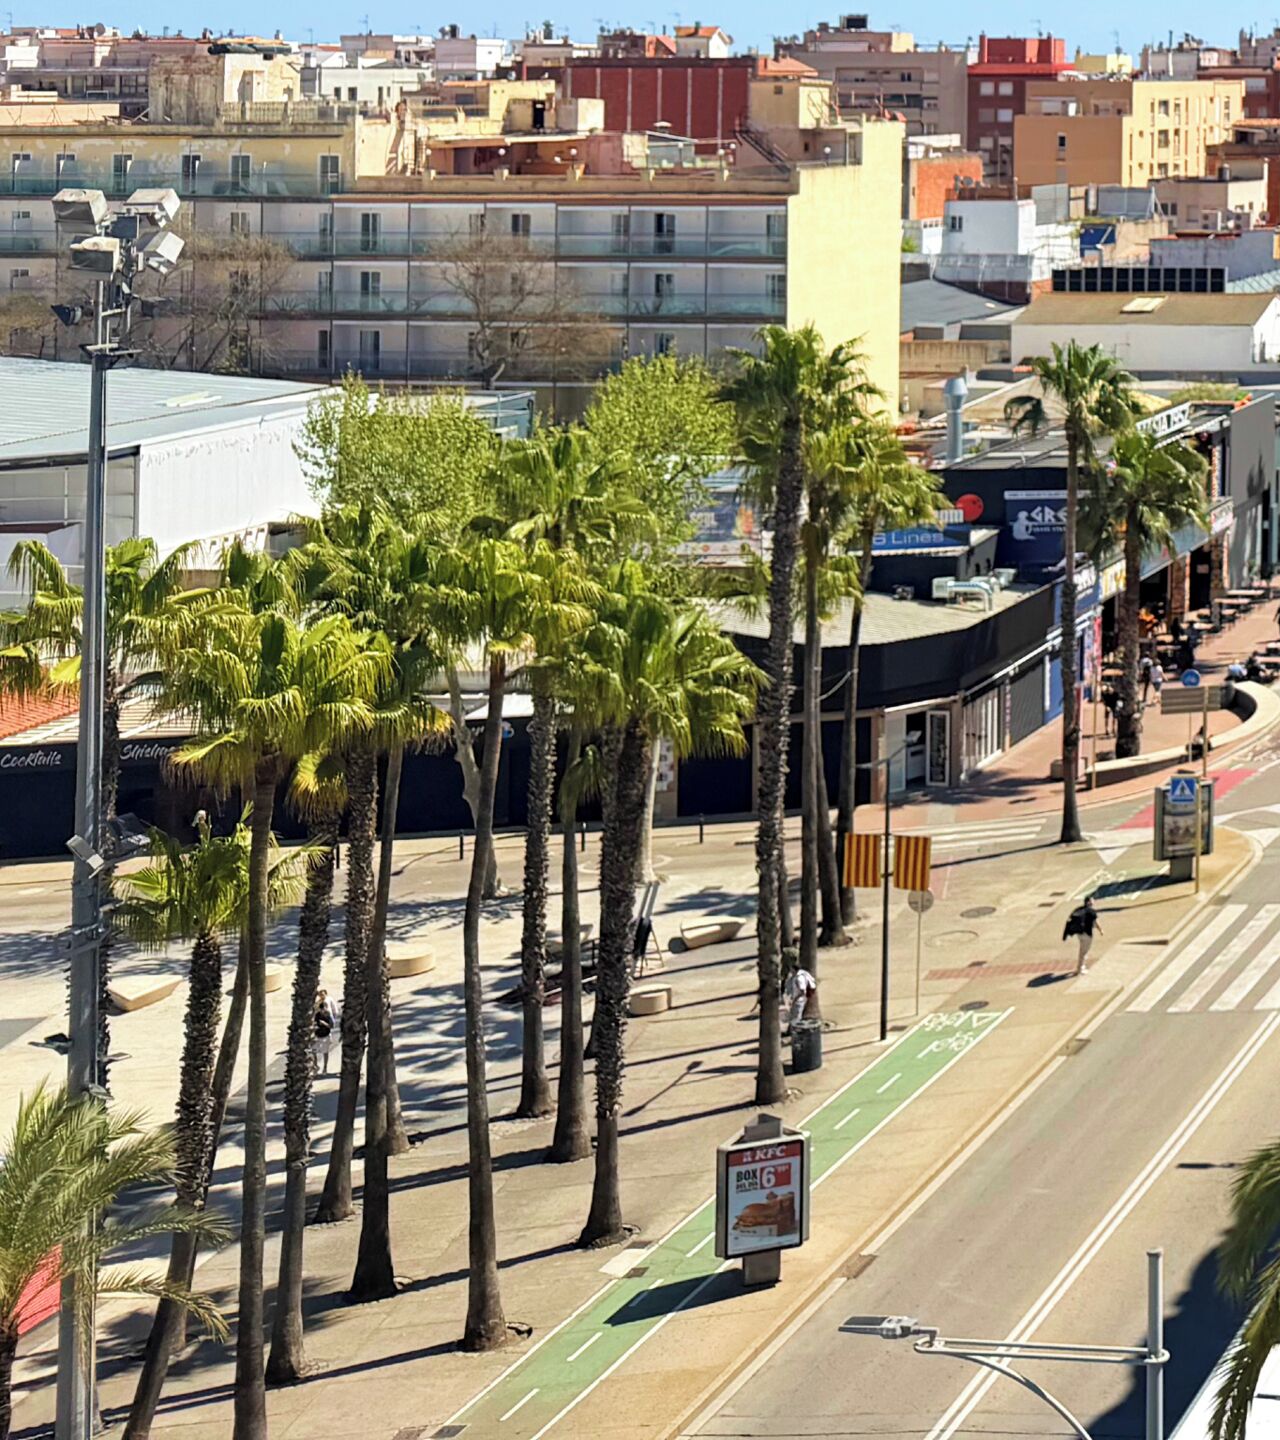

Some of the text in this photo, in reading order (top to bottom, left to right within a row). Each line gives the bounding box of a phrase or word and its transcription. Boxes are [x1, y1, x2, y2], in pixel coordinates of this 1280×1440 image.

[892, 531, 944, 544] Lines
[0, 750, 62, 768] Cocktails
[755, 1146, 787, 1160] KFC
[736, 1168, 758, 1182] BOX
